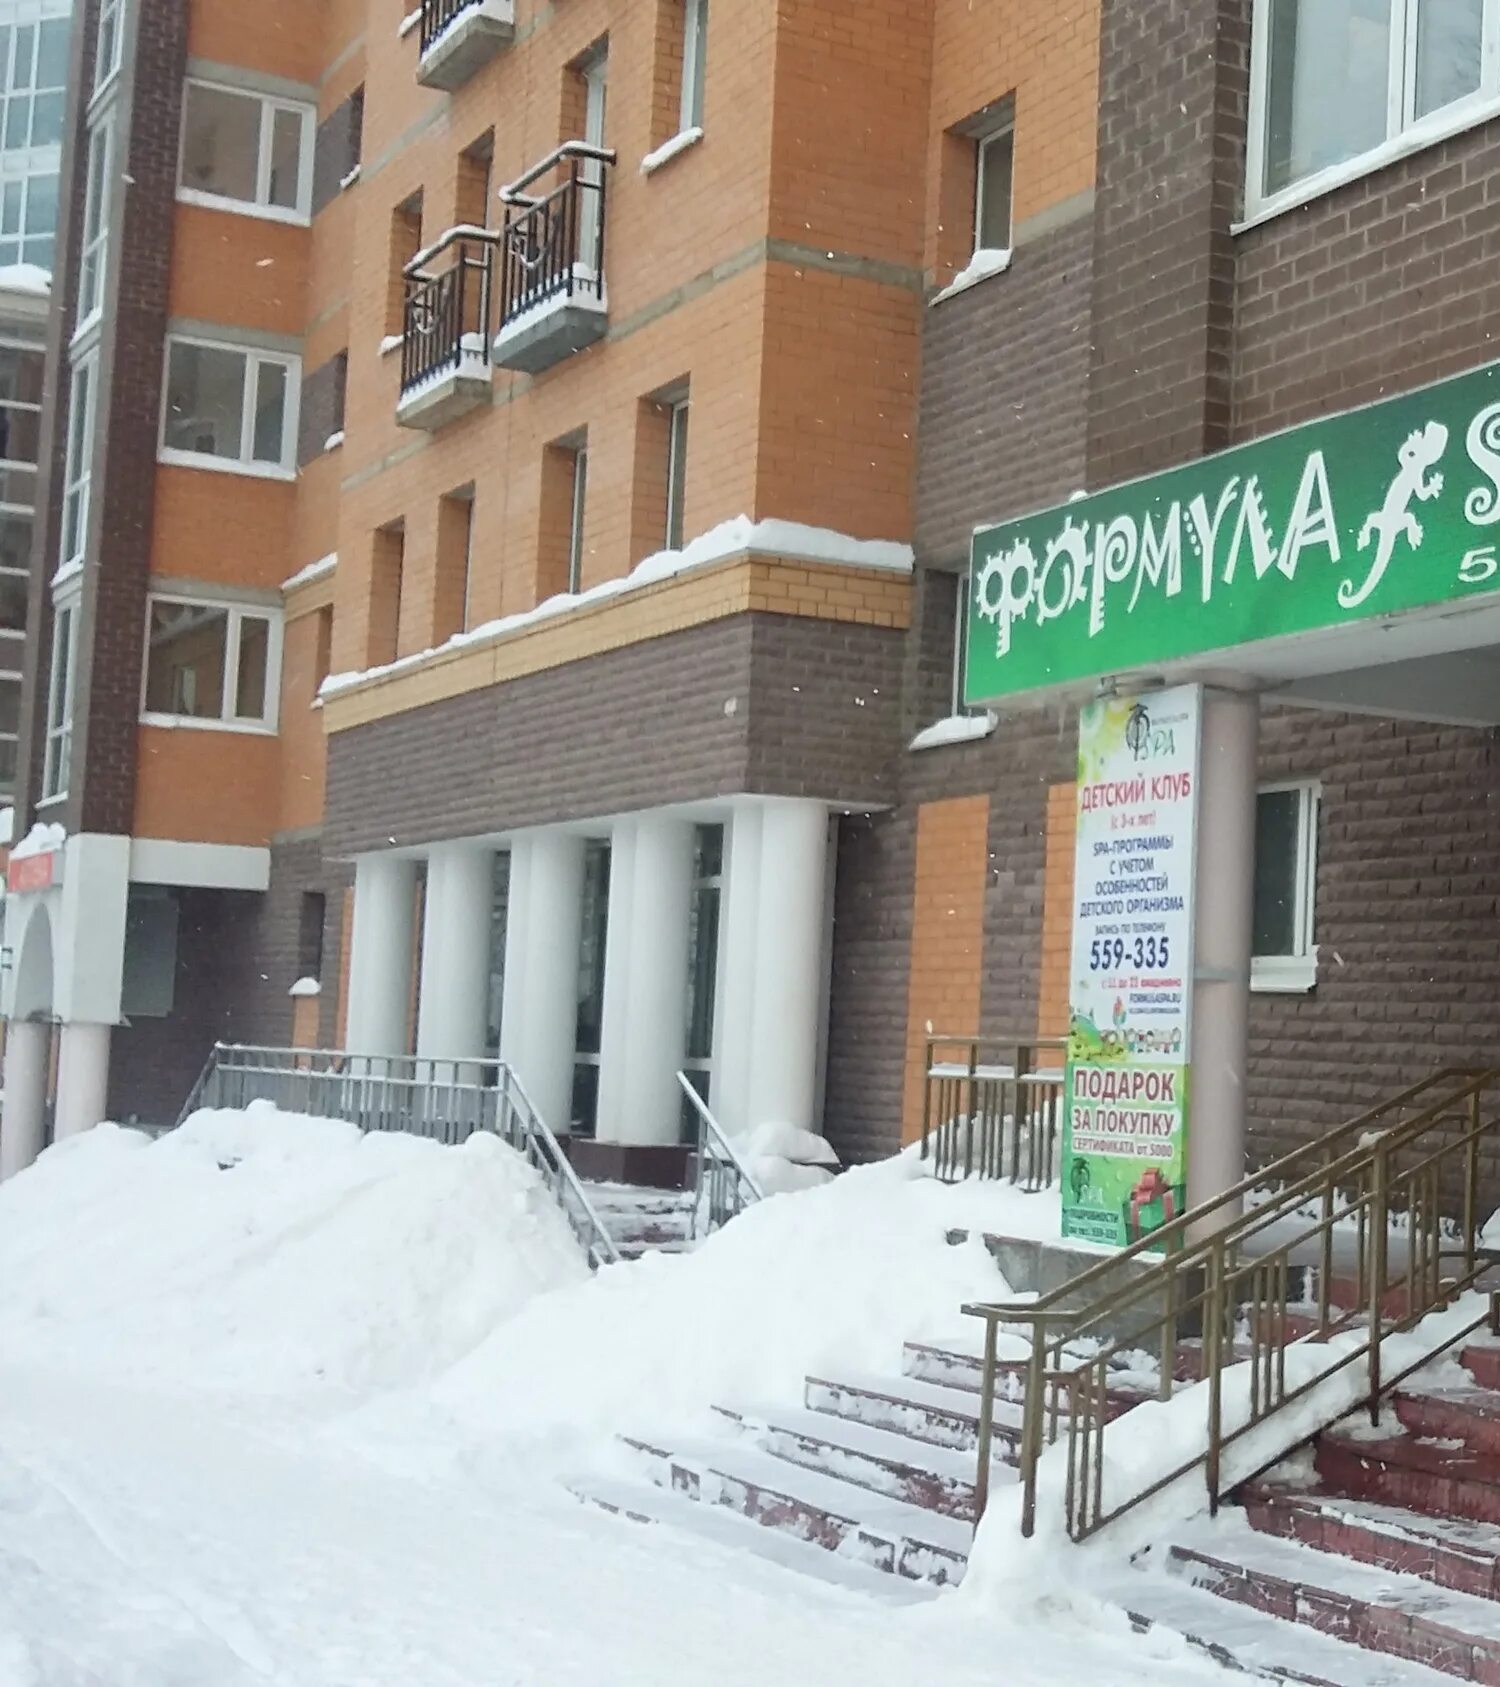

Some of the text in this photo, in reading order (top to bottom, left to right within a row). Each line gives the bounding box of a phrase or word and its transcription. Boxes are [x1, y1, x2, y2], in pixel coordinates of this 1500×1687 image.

[976, 451, 1341, 659] ФОРМУЛА
[1081, 772, 1191, 813] ДЕТСКИЙ КЛУБ
[1093, 834, 1174, 857] SPA-ПРОГРАММЫ
[1118, 857, 1155, 876] УЧЕТОМ
[1095, 872, 1169, 896] ОСОБЕННОСТЕЙ
[1080, 896, 1184, 918] ДЕТСКОГО ОРГАНИЗМА
[1090, 936, 1169, 970] 559-335
[1074, 1069, 1175, 1105] ПОДАРОК
[1073, 1108, 1175, 1137] ЗА ПОКУПКУ
